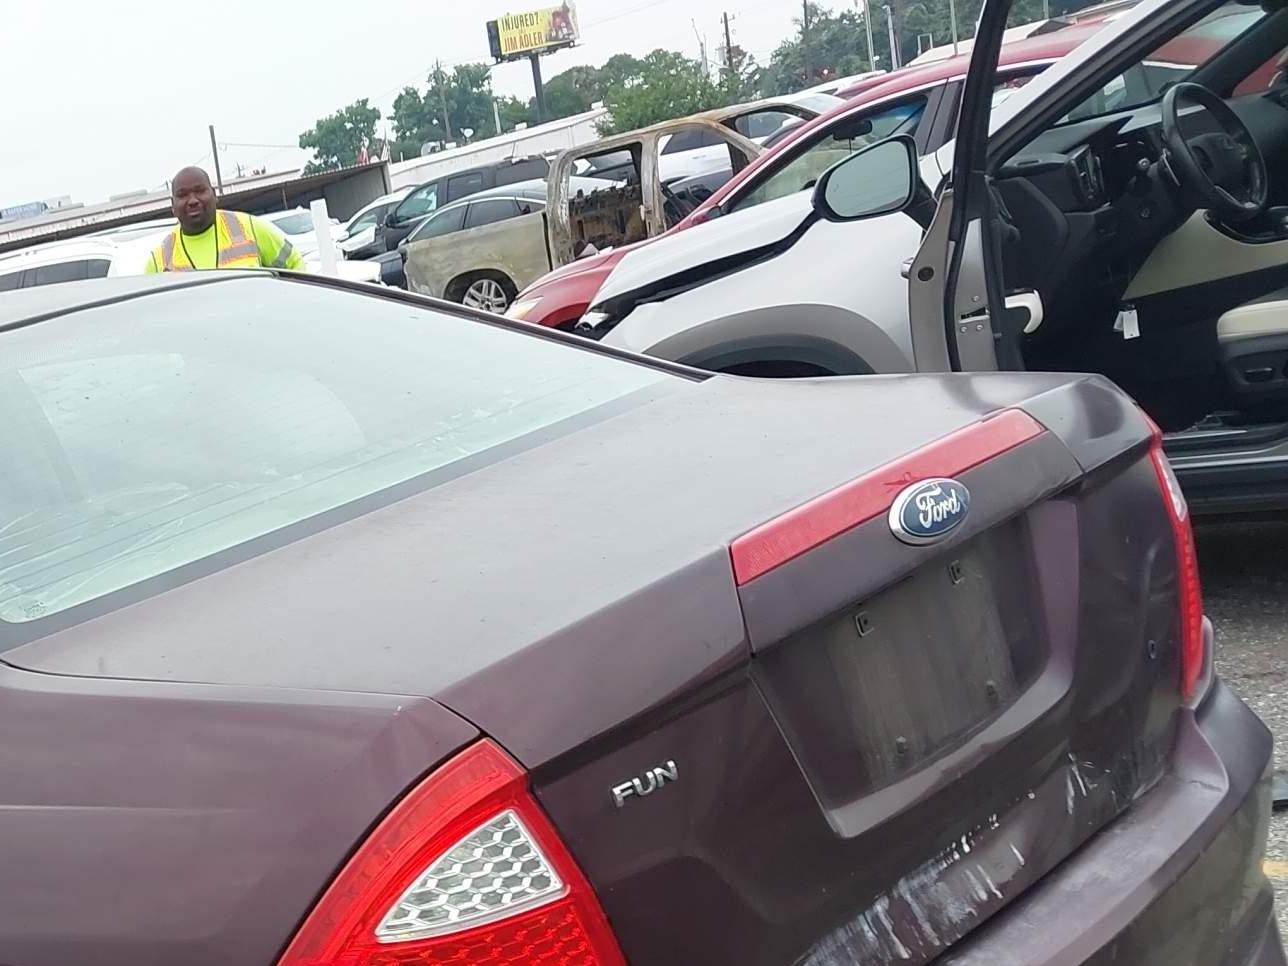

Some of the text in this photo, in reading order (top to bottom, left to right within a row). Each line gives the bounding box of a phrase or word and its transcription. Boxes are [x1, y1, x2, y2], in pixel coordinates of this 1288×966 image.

[504, 32, 543, 52] JIM ADLER
[915, 485, 961, 529] Ford
[611, 759, 679, 808] FUN
